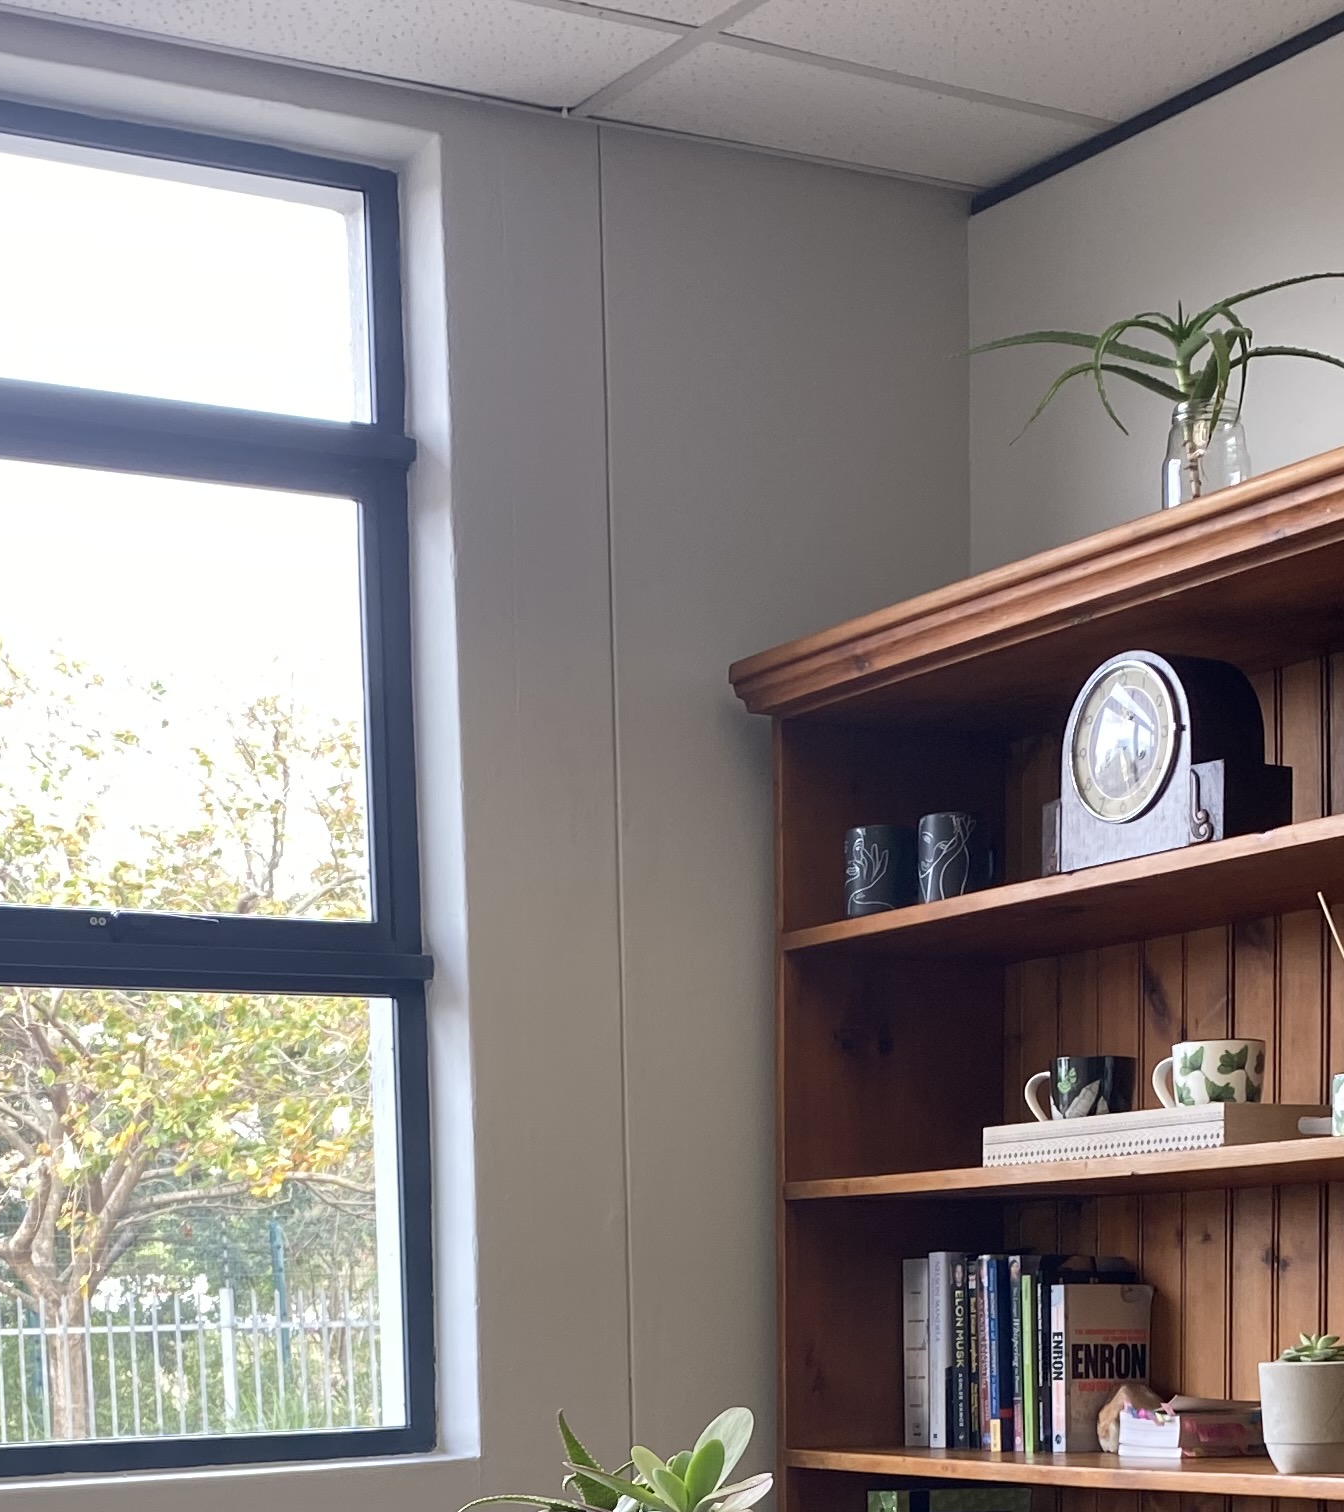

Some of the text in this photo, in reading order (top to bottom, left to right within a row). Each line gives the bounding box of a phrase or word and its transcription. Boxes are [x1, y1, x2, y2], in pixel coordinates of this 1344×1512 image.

[954, 1290, 965, 1368] ELON MUSK
[1052, 1331, 1063, 1381] ENRON
[1071, 1343, 1147, 1380] ENRON
